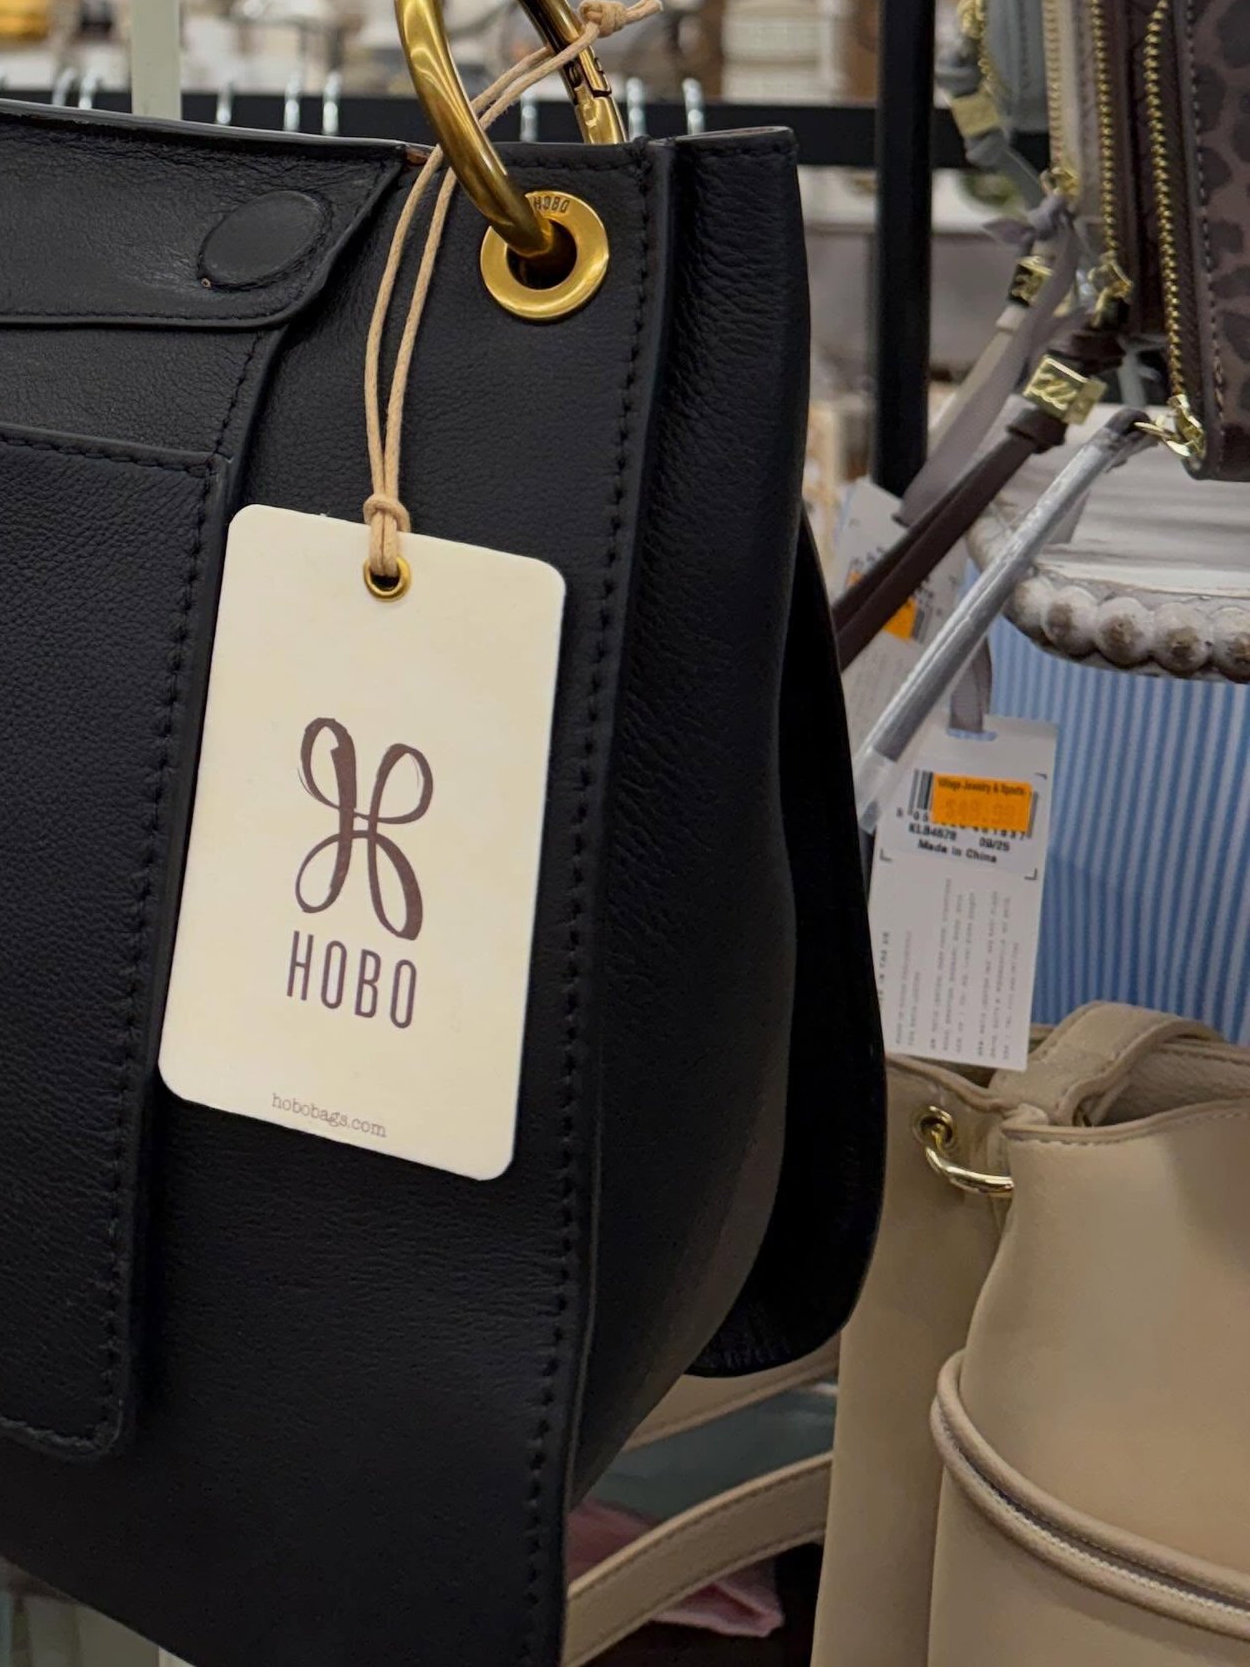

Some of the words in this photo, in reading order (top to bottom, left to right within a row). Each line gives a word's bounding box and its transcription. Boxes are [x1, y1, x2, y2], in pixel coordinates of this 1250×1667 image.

[533, 195, 571, 213] HOBO
[918, 838, 948, 854] Made
[952, 846, 962, 857] in
[966, 848, 997, 864] China
[286, 931, 417, 1028] HOBO
[271, 1093, 387, 1138] hobobags.com
